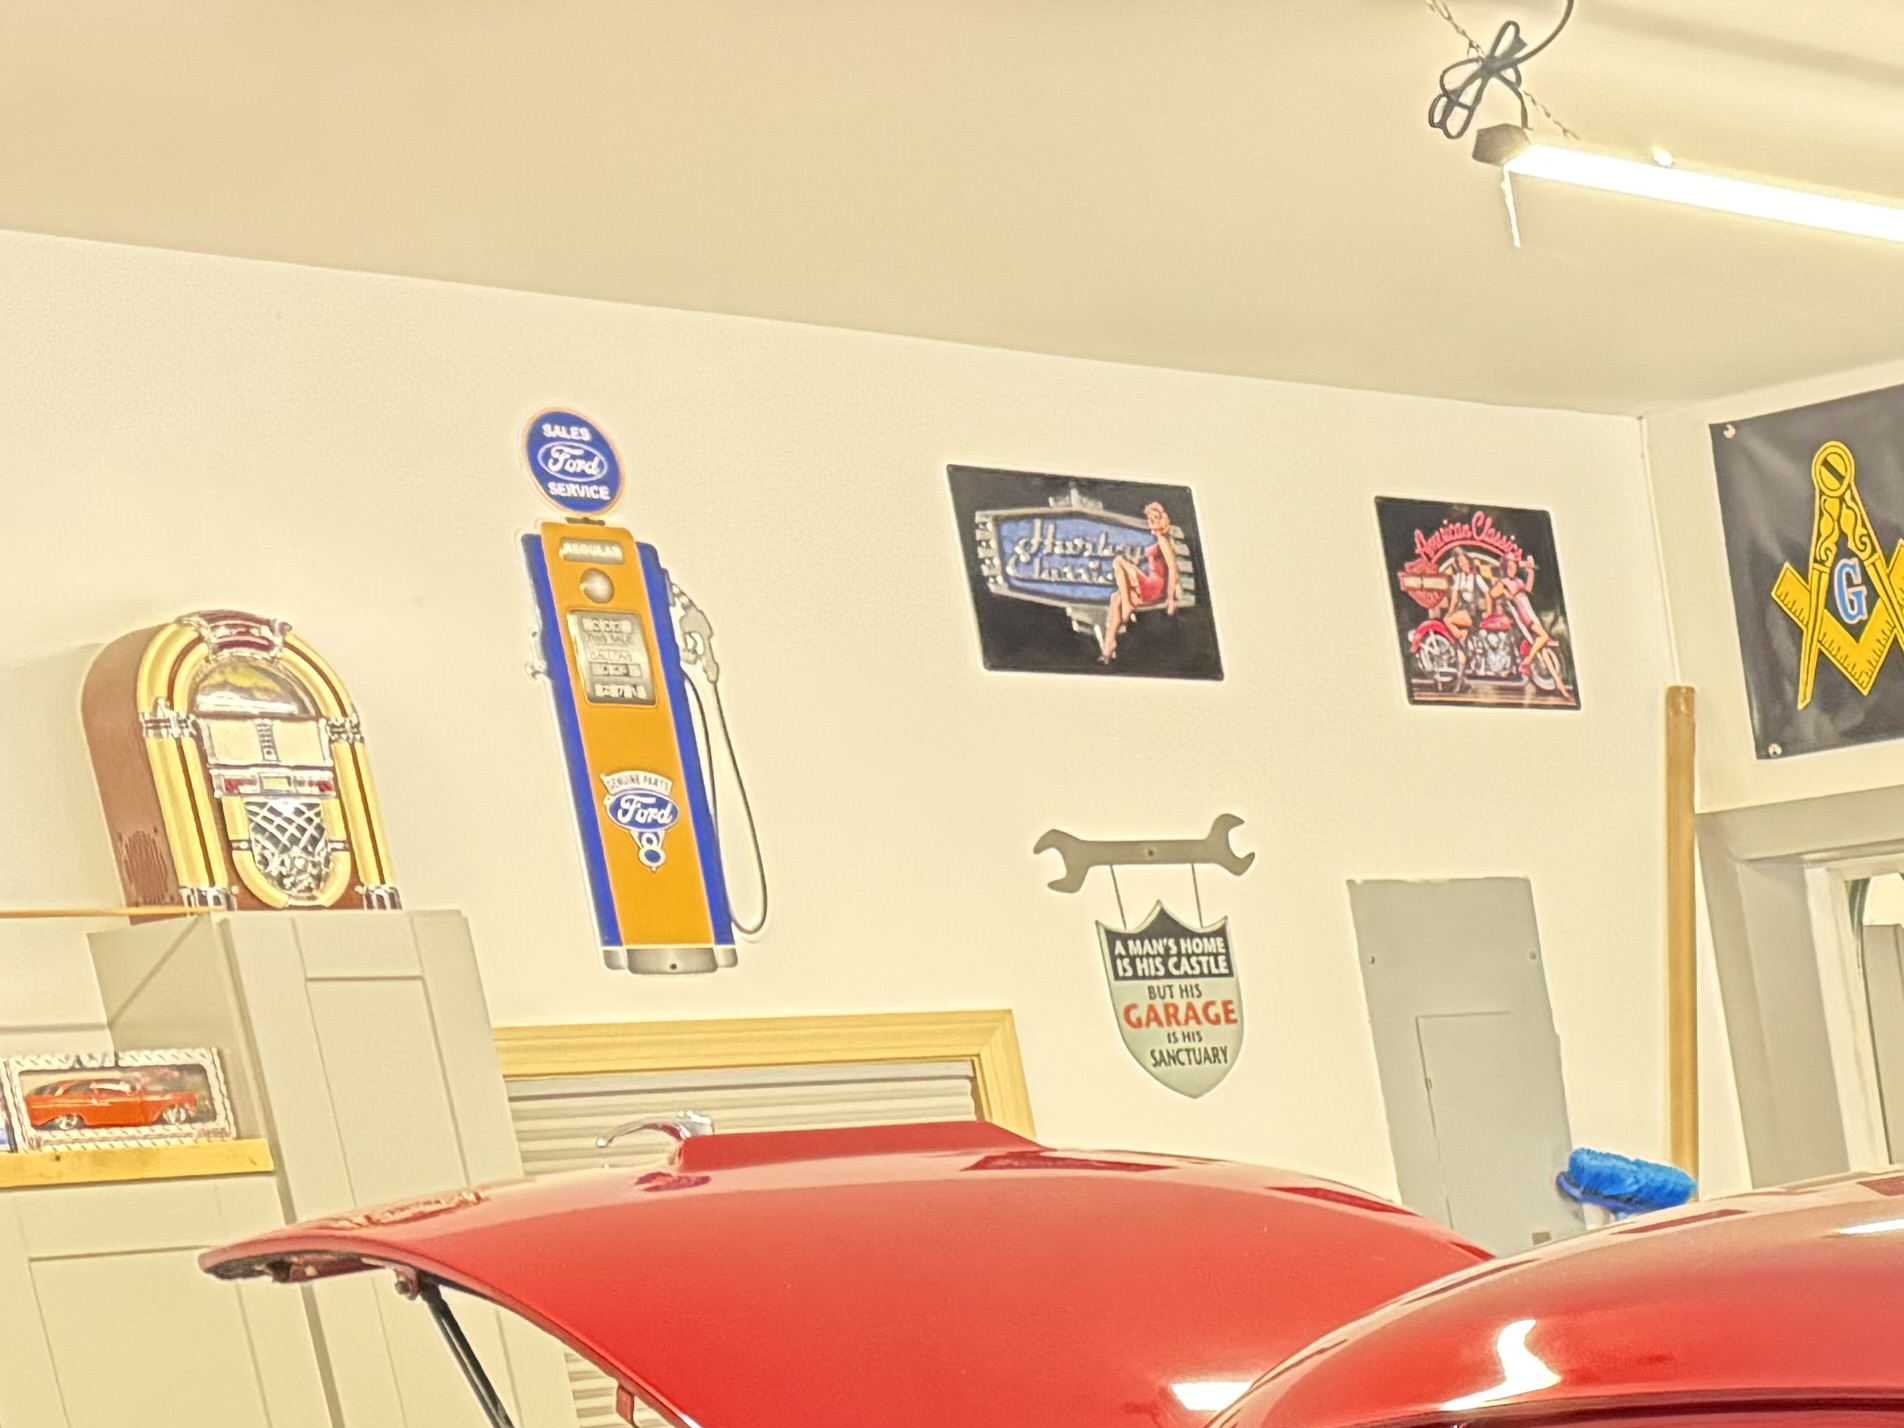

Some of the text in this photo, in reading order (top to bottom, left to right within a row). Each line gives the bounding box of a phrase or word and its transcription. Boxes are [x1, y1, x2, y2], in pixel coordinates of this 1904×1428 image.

[542, 423, 591, 441] SALES
[548, 445, 600, 475] Ford
[548, 481, 611, 500] SERVICE
[1833, 556, 1868, 626] G
[618, 795, 673, 824] Ford
[1115, 937, 1226, 955] A MAN'S HOME
[1116, 955, 1229, 977] IS HIS CASTLE
[1147, 983, 1203, 1000] BUT HIS
[1123, 1000, 1239, 1029] GARAGE
[1167, 1031, 1203, 1044] IS HIS
[1150, 1046, 1228, 1068] SANCTUARY
